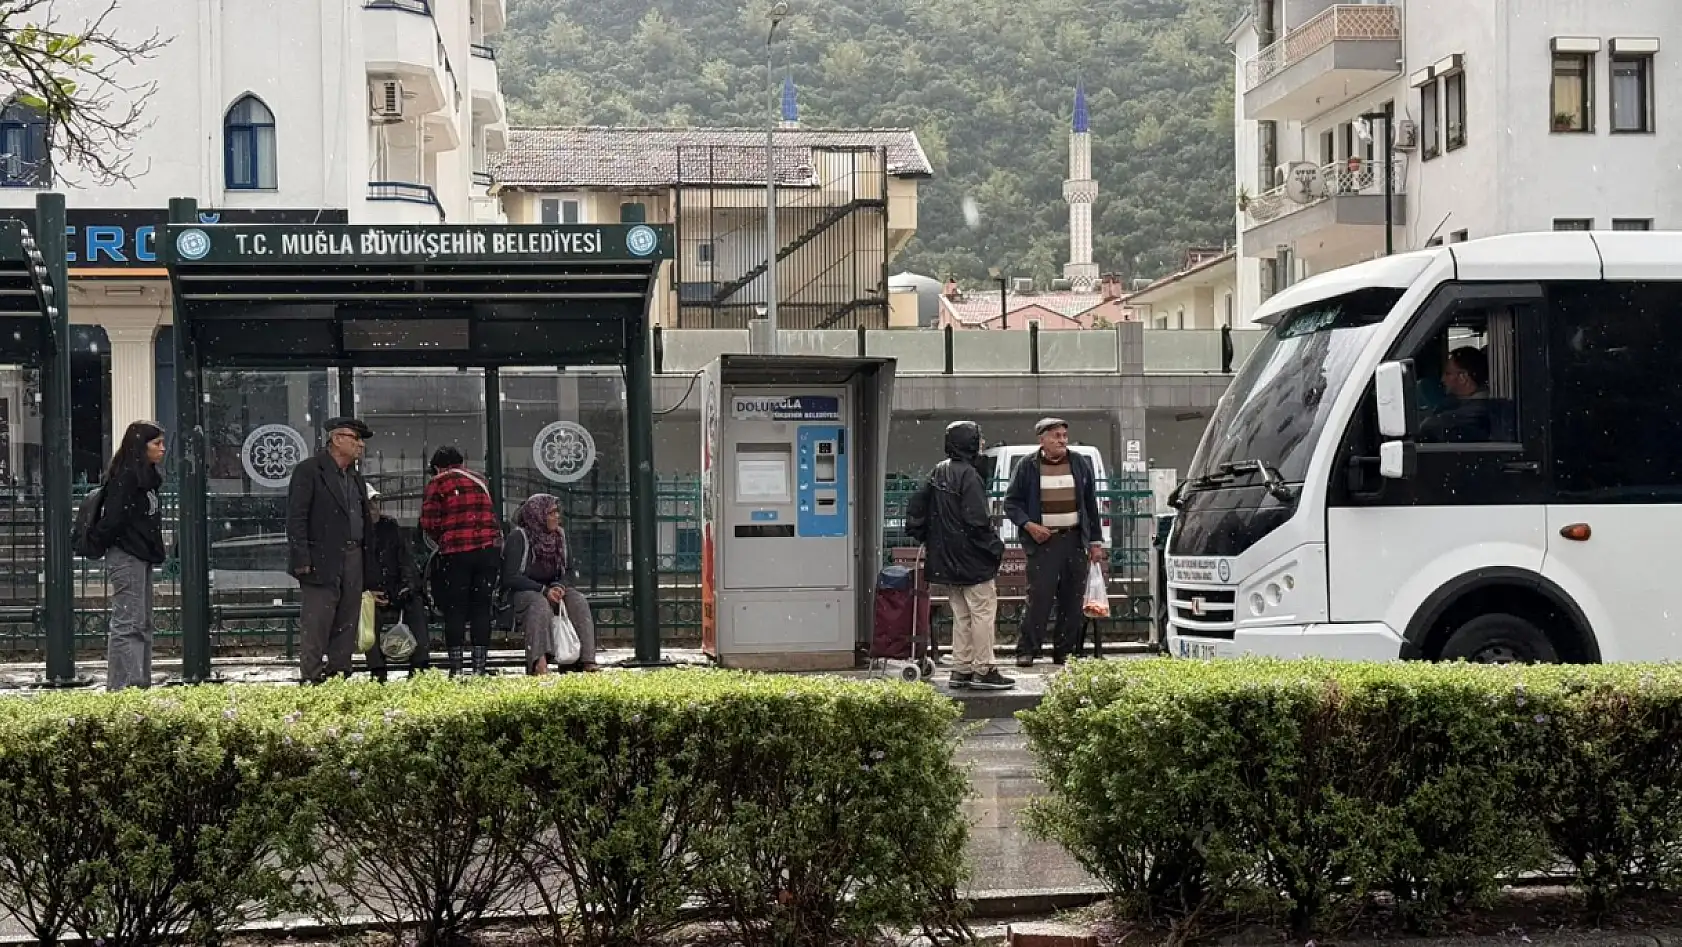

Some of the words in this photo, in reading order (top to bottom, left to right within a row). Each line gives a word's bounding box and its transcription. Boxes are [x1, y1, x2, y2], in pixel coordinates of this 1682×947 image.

[235, 234, 274, 255] T.C.
[281, 230, 354, 255] MUĞLA
[361, 229, 486, 258] BÜYÜKŞEHİR
[493, 229, 602, 254] BELEDİYESİ
